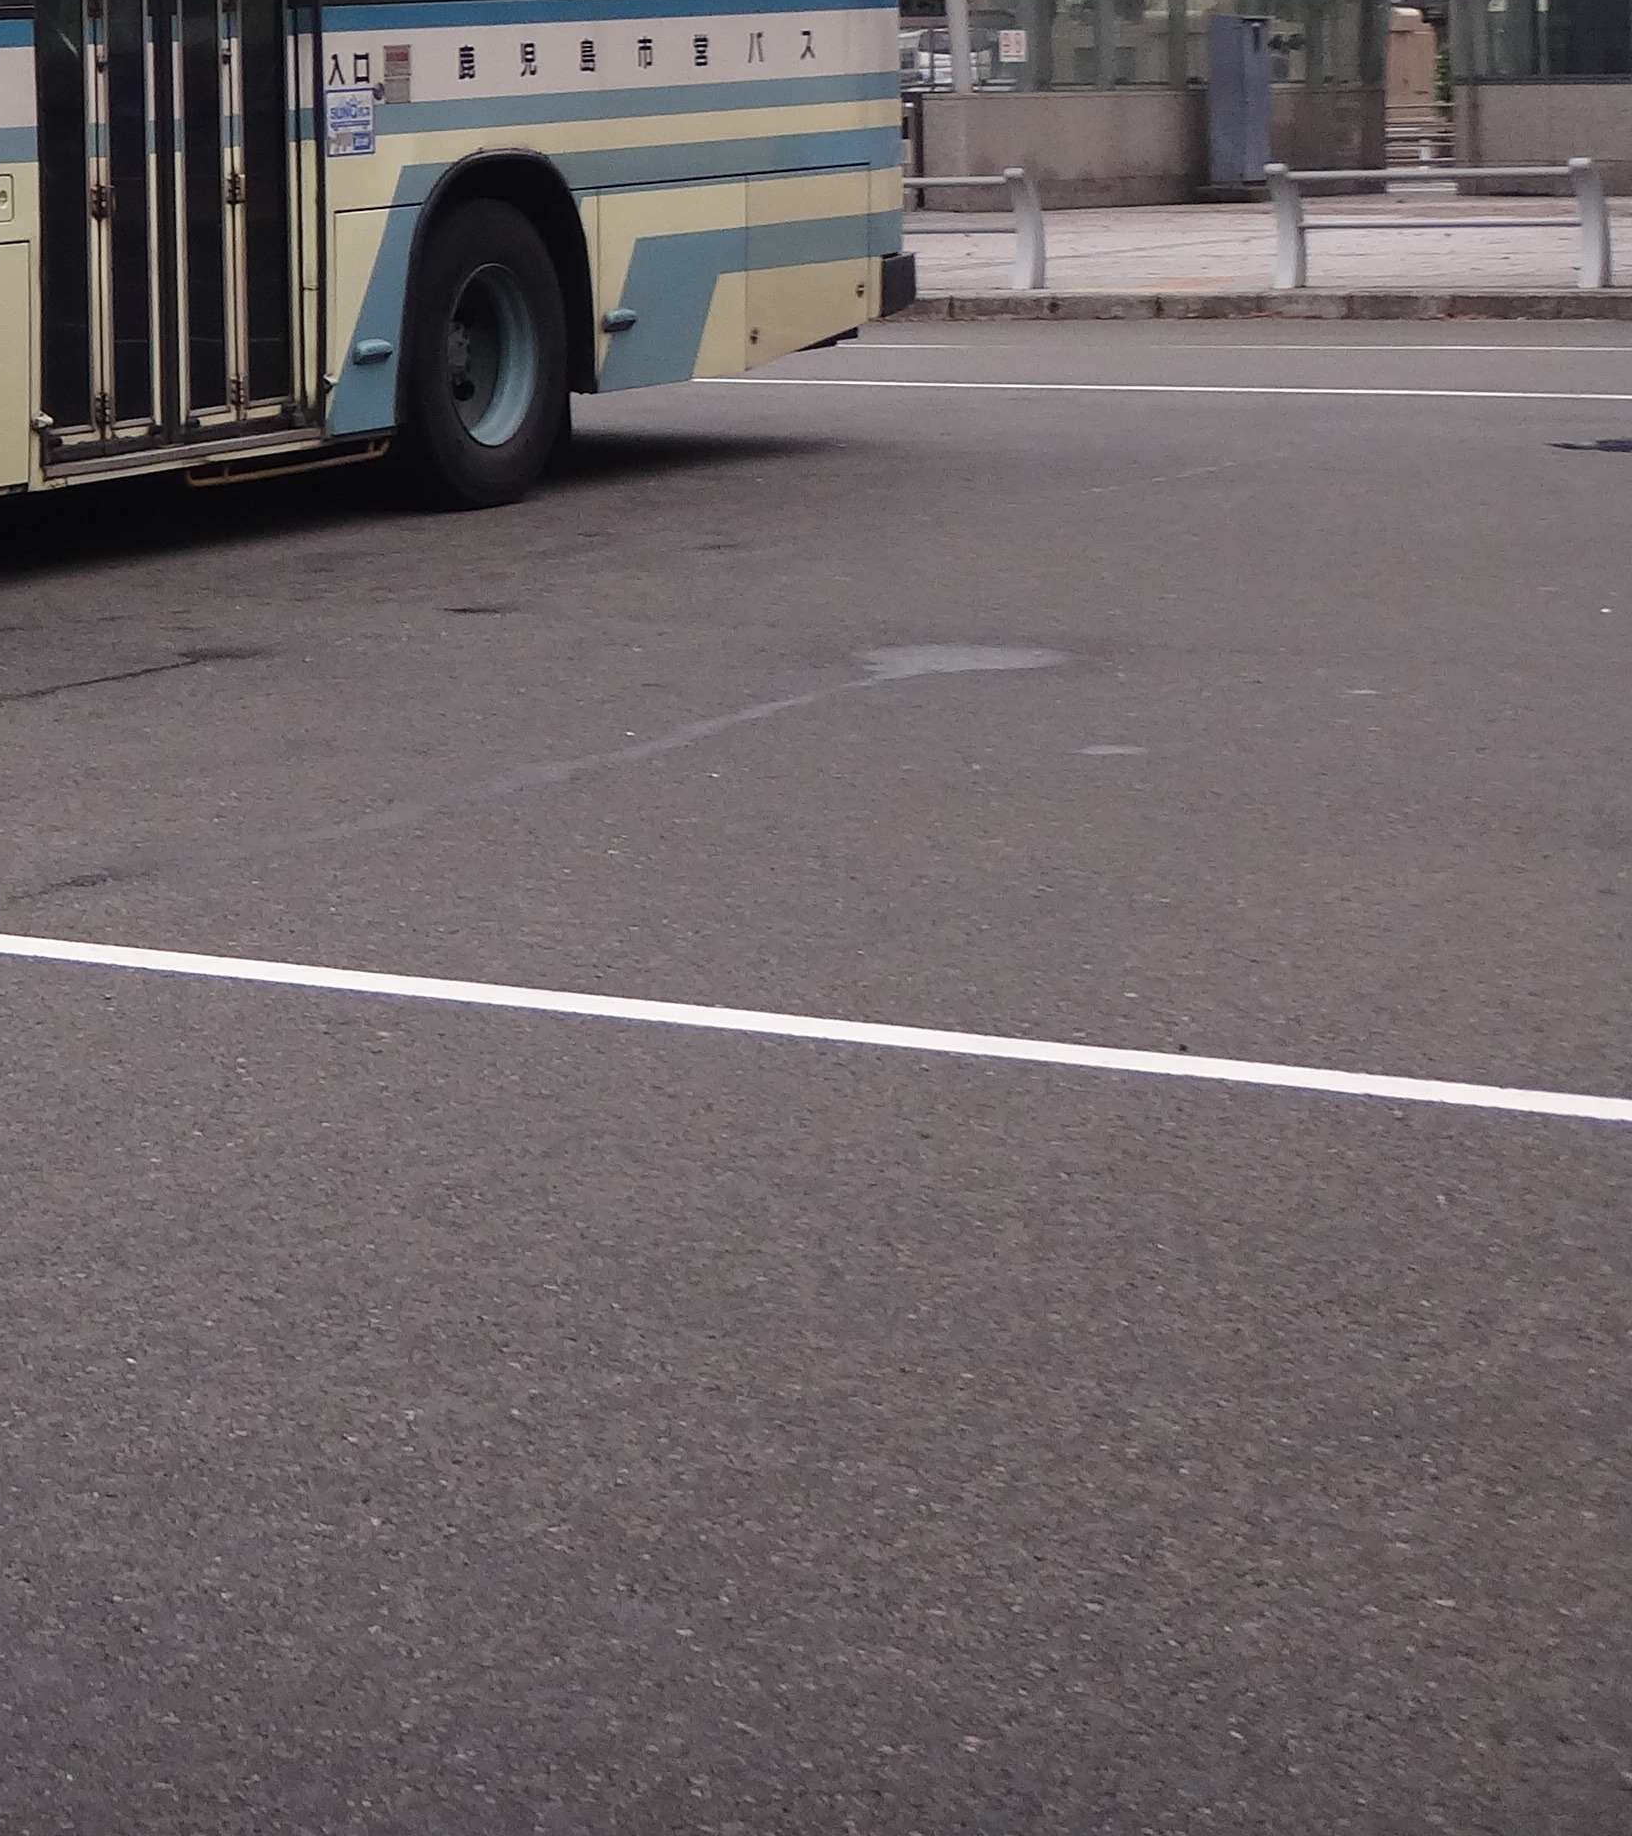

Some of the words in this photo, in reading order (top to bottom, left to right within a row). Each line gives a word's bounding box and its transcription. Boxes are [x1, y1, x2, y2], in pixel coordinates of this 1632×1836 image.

[328, 53, 370, 86] 入口
[458, 29, 816, 81] 鹿児島市営バス
